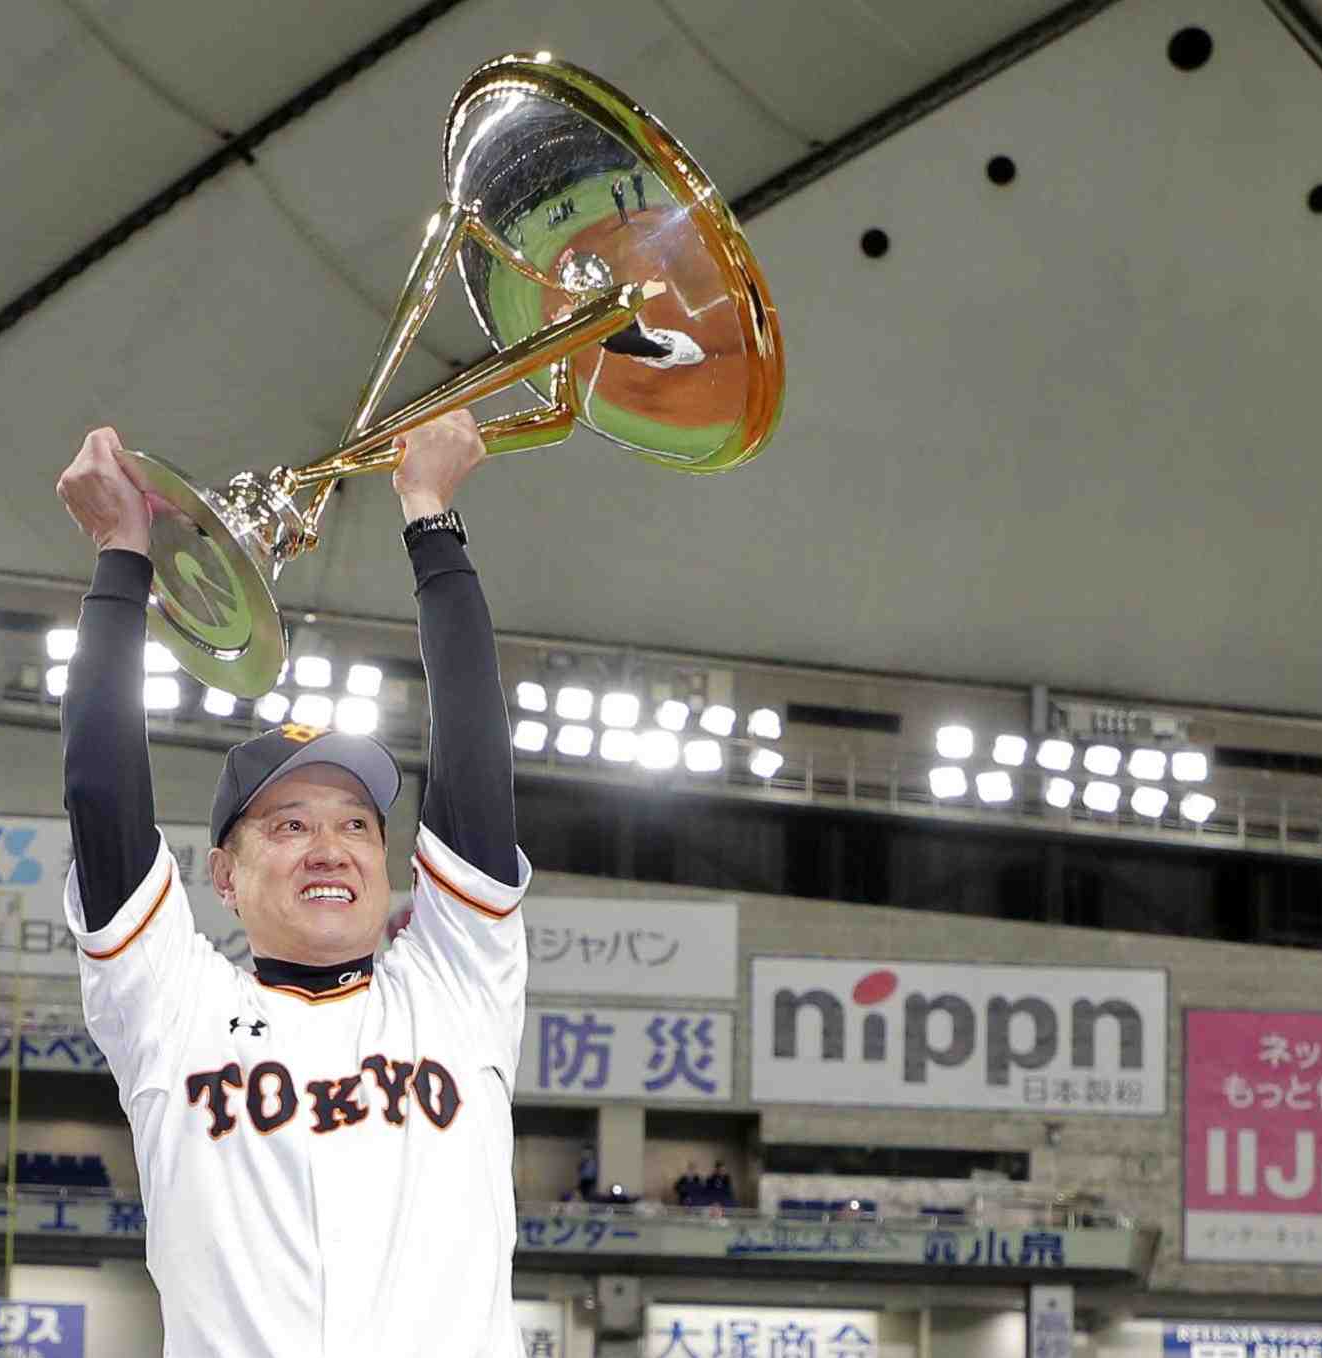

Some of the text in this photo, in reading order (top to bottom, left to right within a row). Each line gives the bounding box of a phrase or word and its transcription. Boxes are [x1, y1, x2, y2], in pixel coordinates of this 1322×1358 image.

[538, 1013, 717, 1094] 防災
[773, 970, 1144, 1086] nippn
[185, 1054, 463, 1141] TOKYO
